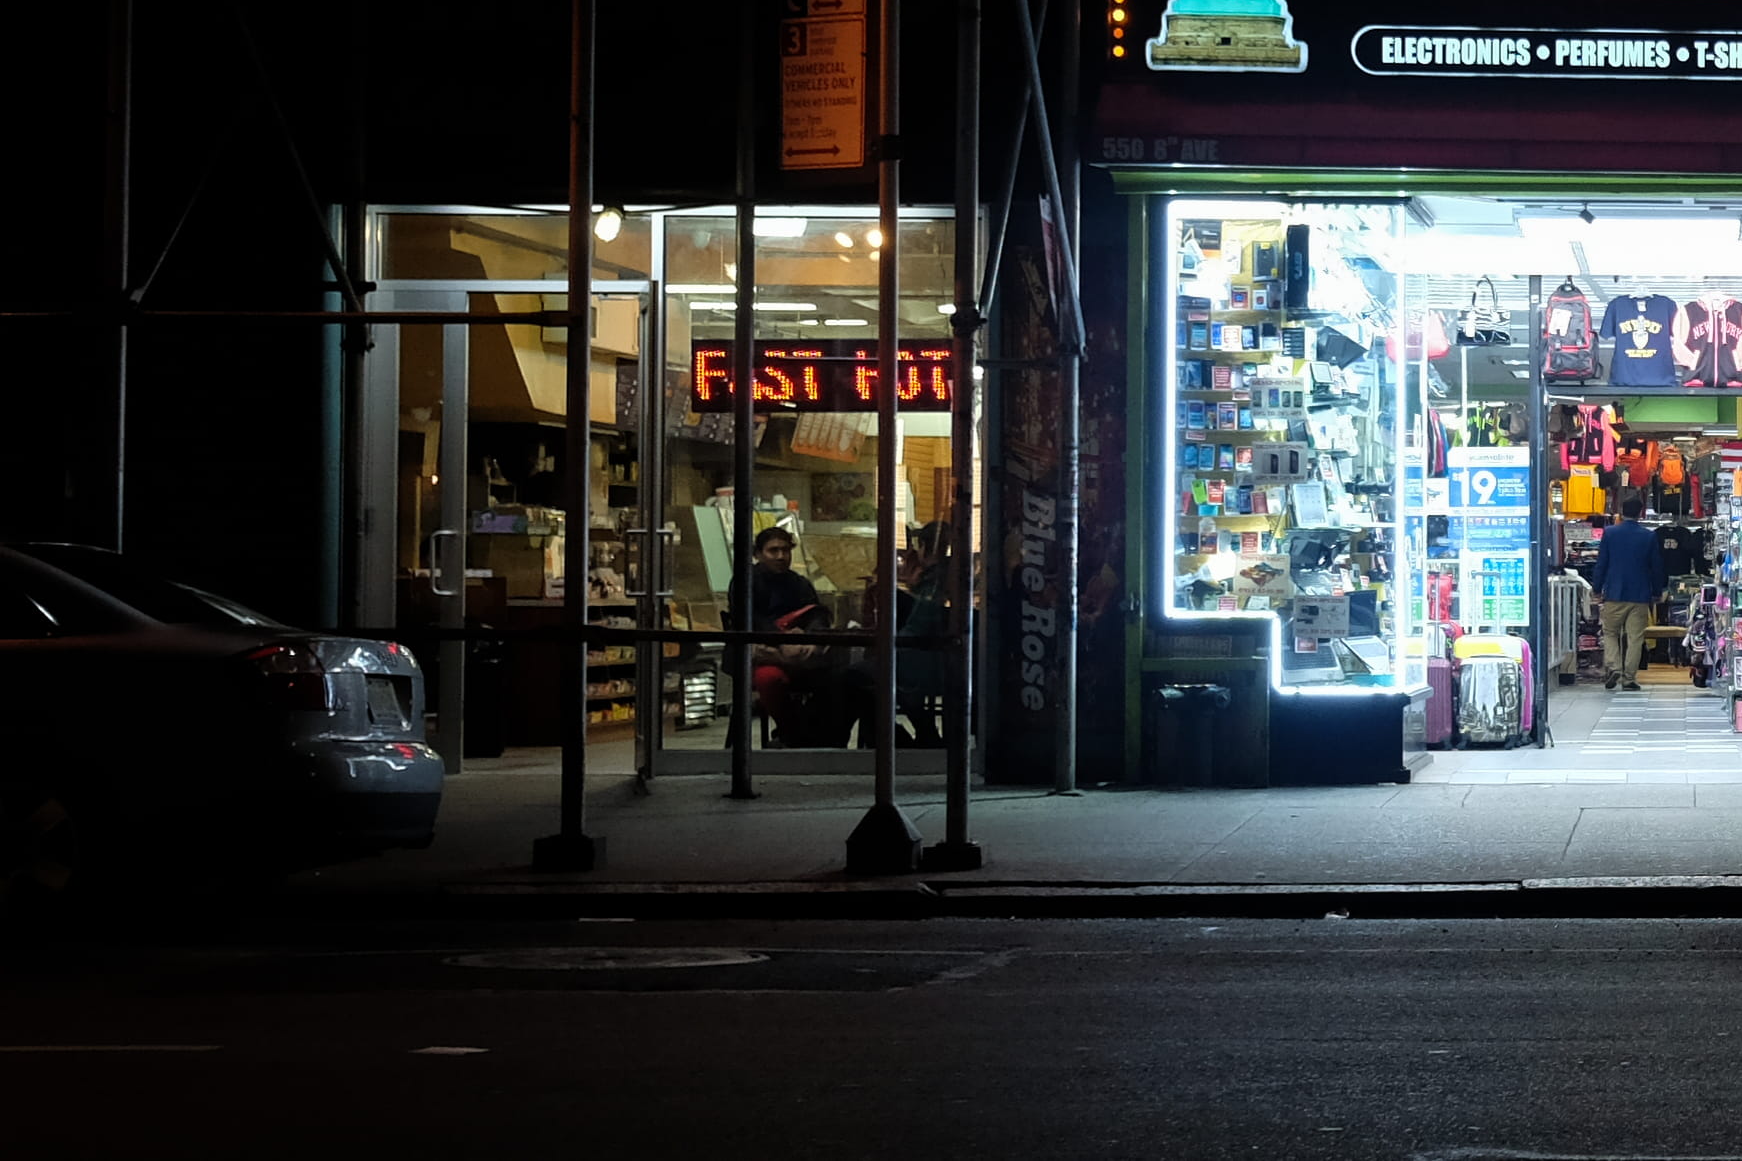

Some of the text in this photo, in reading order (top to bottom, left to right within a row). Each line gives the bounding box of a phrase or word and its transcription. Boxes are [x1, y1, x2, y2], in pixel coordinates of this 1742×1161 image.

[1381, 37, 1531, 65] ELECTRONICS
[1555, 40, 1670, 68] PERFUMES
[785, 61, 846, 77] COMMERCIAL
[784, 76, 856, 93] VEHICLES ONLY
[1102, 137, 1144, 160] 550
[1180, 138, 1219, 161] AVE
[1693, 321, 1710, 340] NEW
[1021, 489, 1057, 712] Blue Rose
